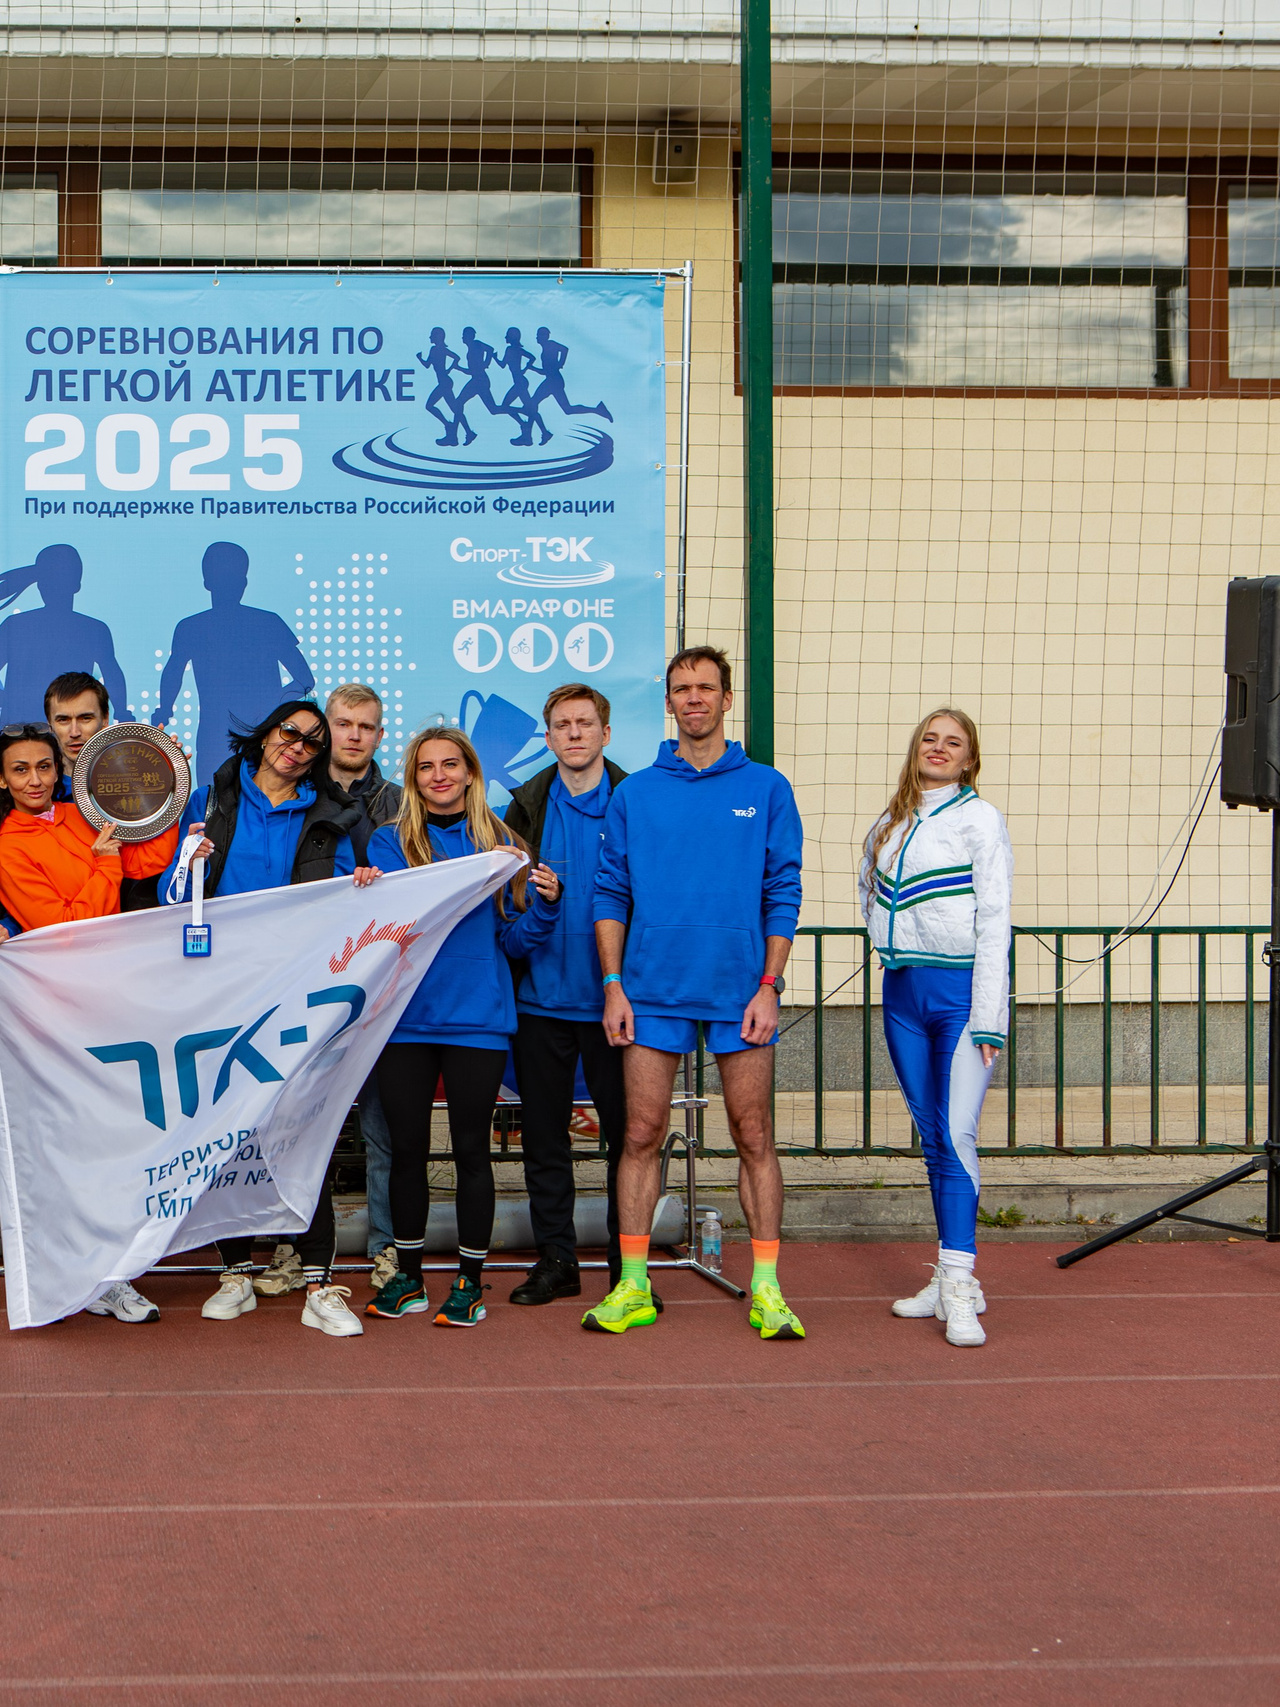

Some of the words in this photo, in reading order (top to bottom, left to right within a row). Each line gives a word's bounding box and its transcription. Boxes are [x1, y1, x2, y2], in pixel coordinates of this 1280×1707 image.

[25, 326, 319, 355] СОРЕВНОВАНИЯ
[332, 326, 384, 355] ПО
[24, 359, 191, 402] ЛЕГКОЙ
[205, 368, 416, 402] АТЛЕТИКЕ
[24, 413, 303, 491] 2025
[25, 497, 66, 519] При
[73, 501, 194, 519] поддержке
[201, 497, 357, 519] Правительства
[364, 496, 486, 515] Российской
[492, 496, 615, 518] Федерации
[452, 598, 615, 619] ВМАРАФОНЕ
[97, 783, 130, 793] 2025
